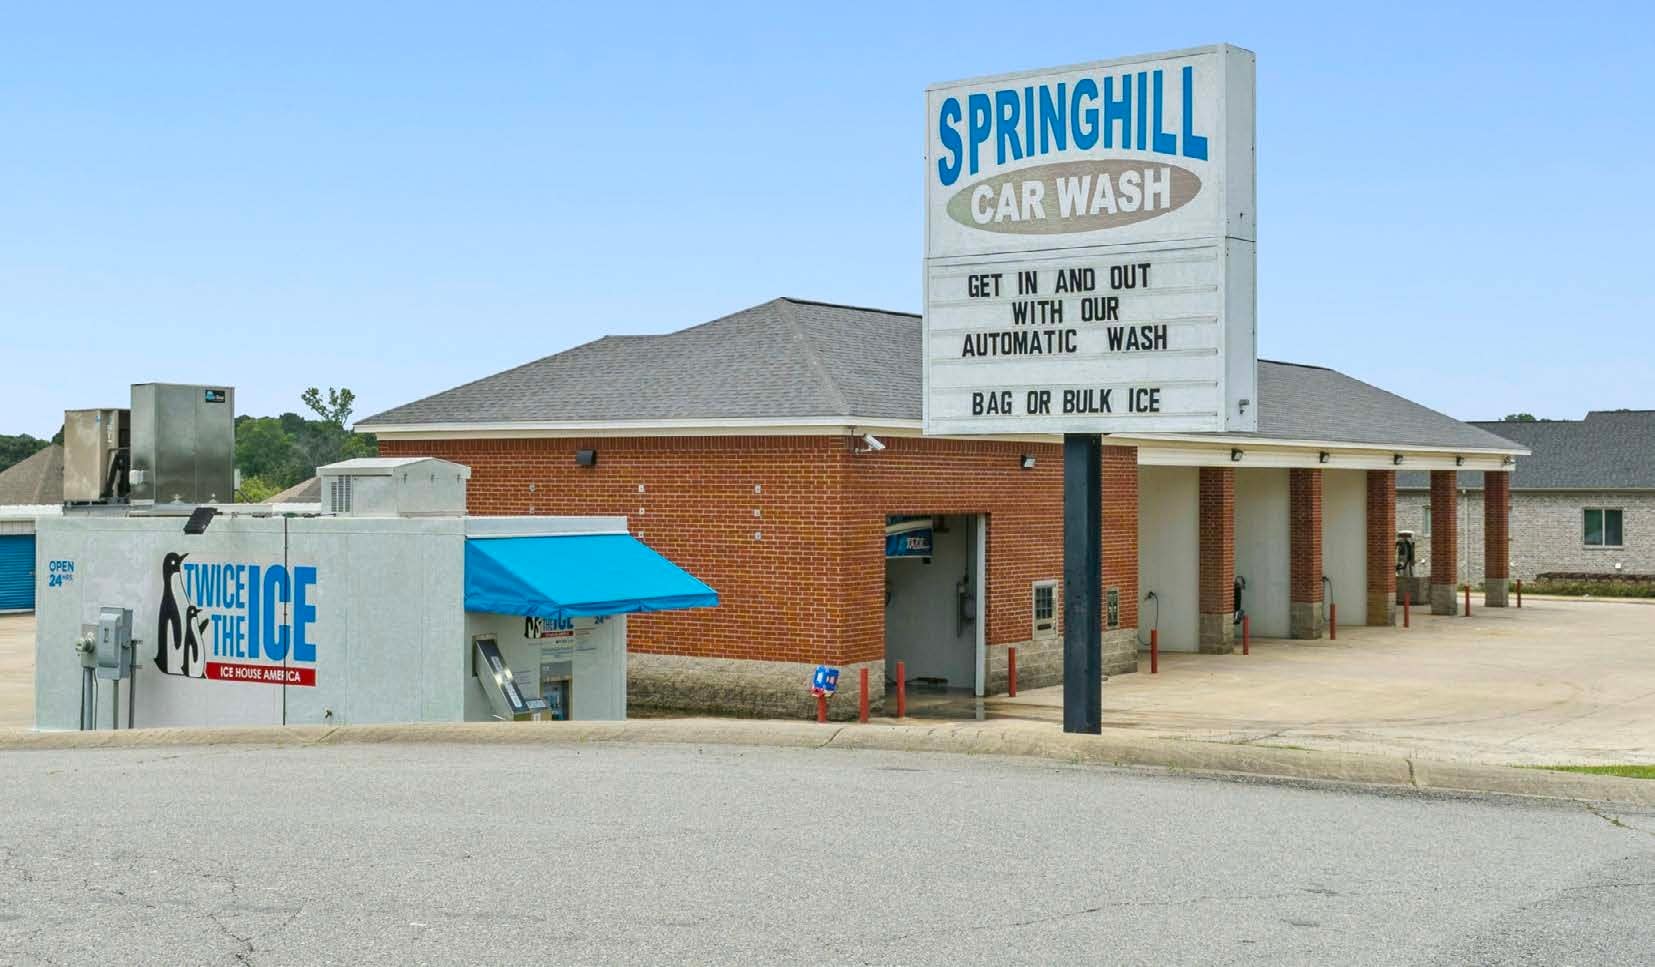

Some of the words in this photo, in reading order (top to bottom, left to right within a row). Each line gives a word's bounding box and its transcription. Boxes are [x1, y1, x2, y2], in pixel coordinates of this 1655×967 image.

[938, 66, 1208, 186] SPRINGHILL
[970, 180, 1046, 225] CAR
[1056, 167, 1171, 218] WASH
[968, 273, 1002, 298] GET
[1018, 271, 1037, 295] IN
[1055, 268, 1095, 293] AND
[1110, 263, 1151, 290] OUT
[1012, 300, 1063, 325] WITH
[1081, 297, 1119, 322] OUR
[962, 329, 1077, 357] AUTOMATIC
[1107, 325, 1168, 351] WASH
[972, 391, 1012, 415] BAG
[1027, 390, 1050, 414] OR
[1063, 389, 1112, 414] BULK
[1129, 388, 1160, 412] ICE
[49, 560, 74, 572] OPEN
[49, 574, 62, 587] 24
[184, 563, 246, 609] TWICE
[211, 614, 246, 658] THE
[249, 564, 317, 662] ICE
[220, 666, 233, 677] ICE
[235, 667, 261, 680] HOUSE
